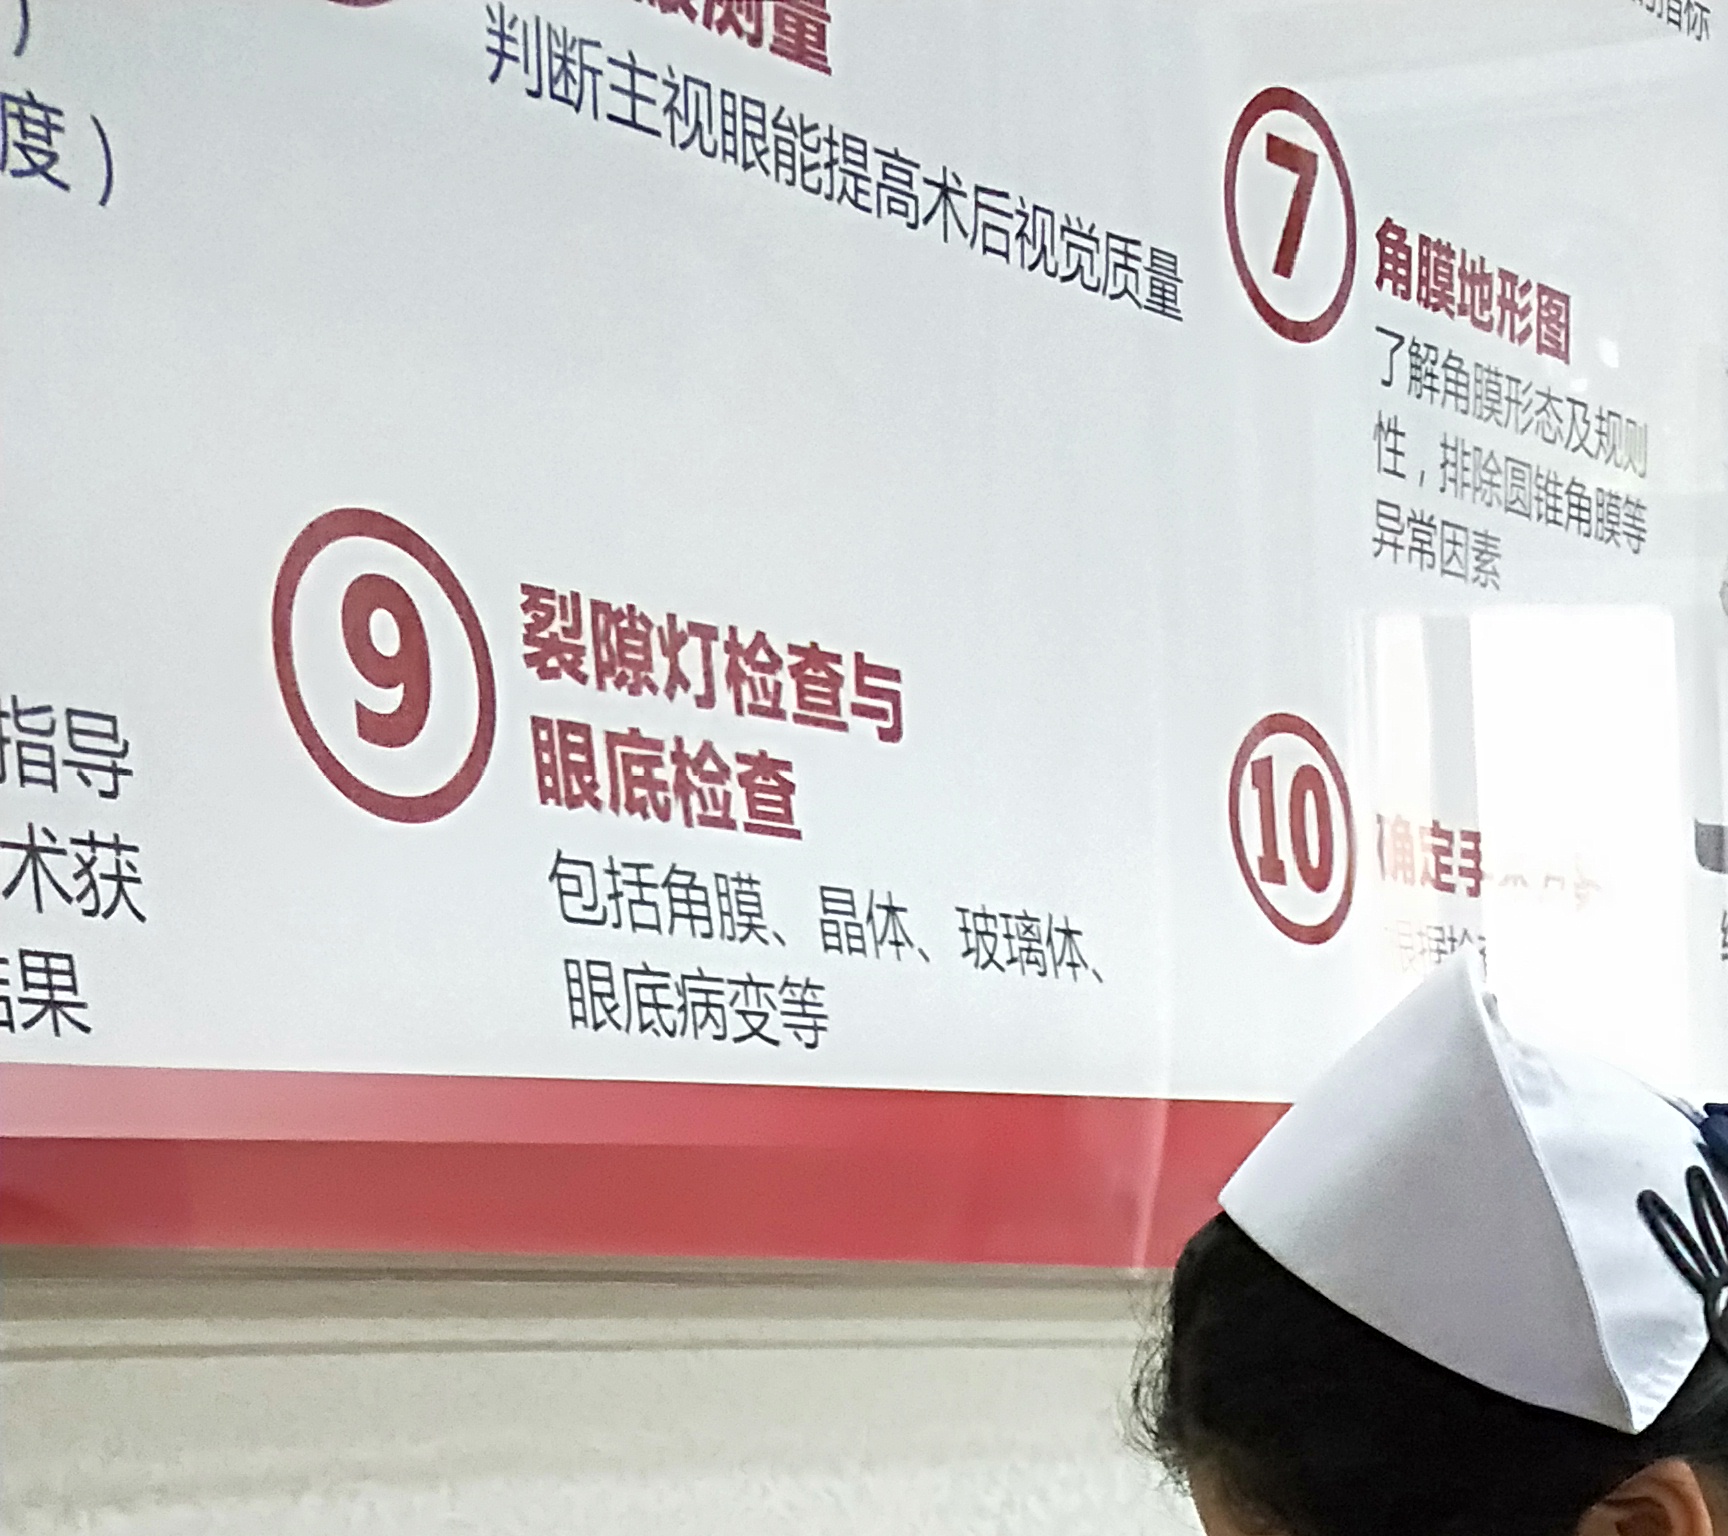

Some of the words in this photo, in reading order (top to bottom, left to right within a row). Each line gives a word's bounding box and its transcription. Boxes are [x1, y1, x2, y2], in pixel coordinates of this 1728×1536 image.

[484, 3, 1184, 323] 判断主视眼能提高术后视觉质量
[1265, 132, 1319, 280] 7
[1374, 216, 1572, 365] 角膜地形图
[1374, 325, 1649, 479] 了解角膜形态及规则
[1372, 409, 1649, 556] 性，排除圆锥角膜等
[1372, 498, 1502, 591] 异常因素
[341, 573, 431, 749] 9
[520, 582, 904, 744] 裂隙灯检查与
[531, 715, 803, 841] 眼底检查
[1250, 755, 1335, 893] 10
[0, 821, 148, 924] 术获
[548, 848, 1104, 984] 包括角膜、晶体、玻璃体、
[563, 958, 830, 1050] 眼底病变等
